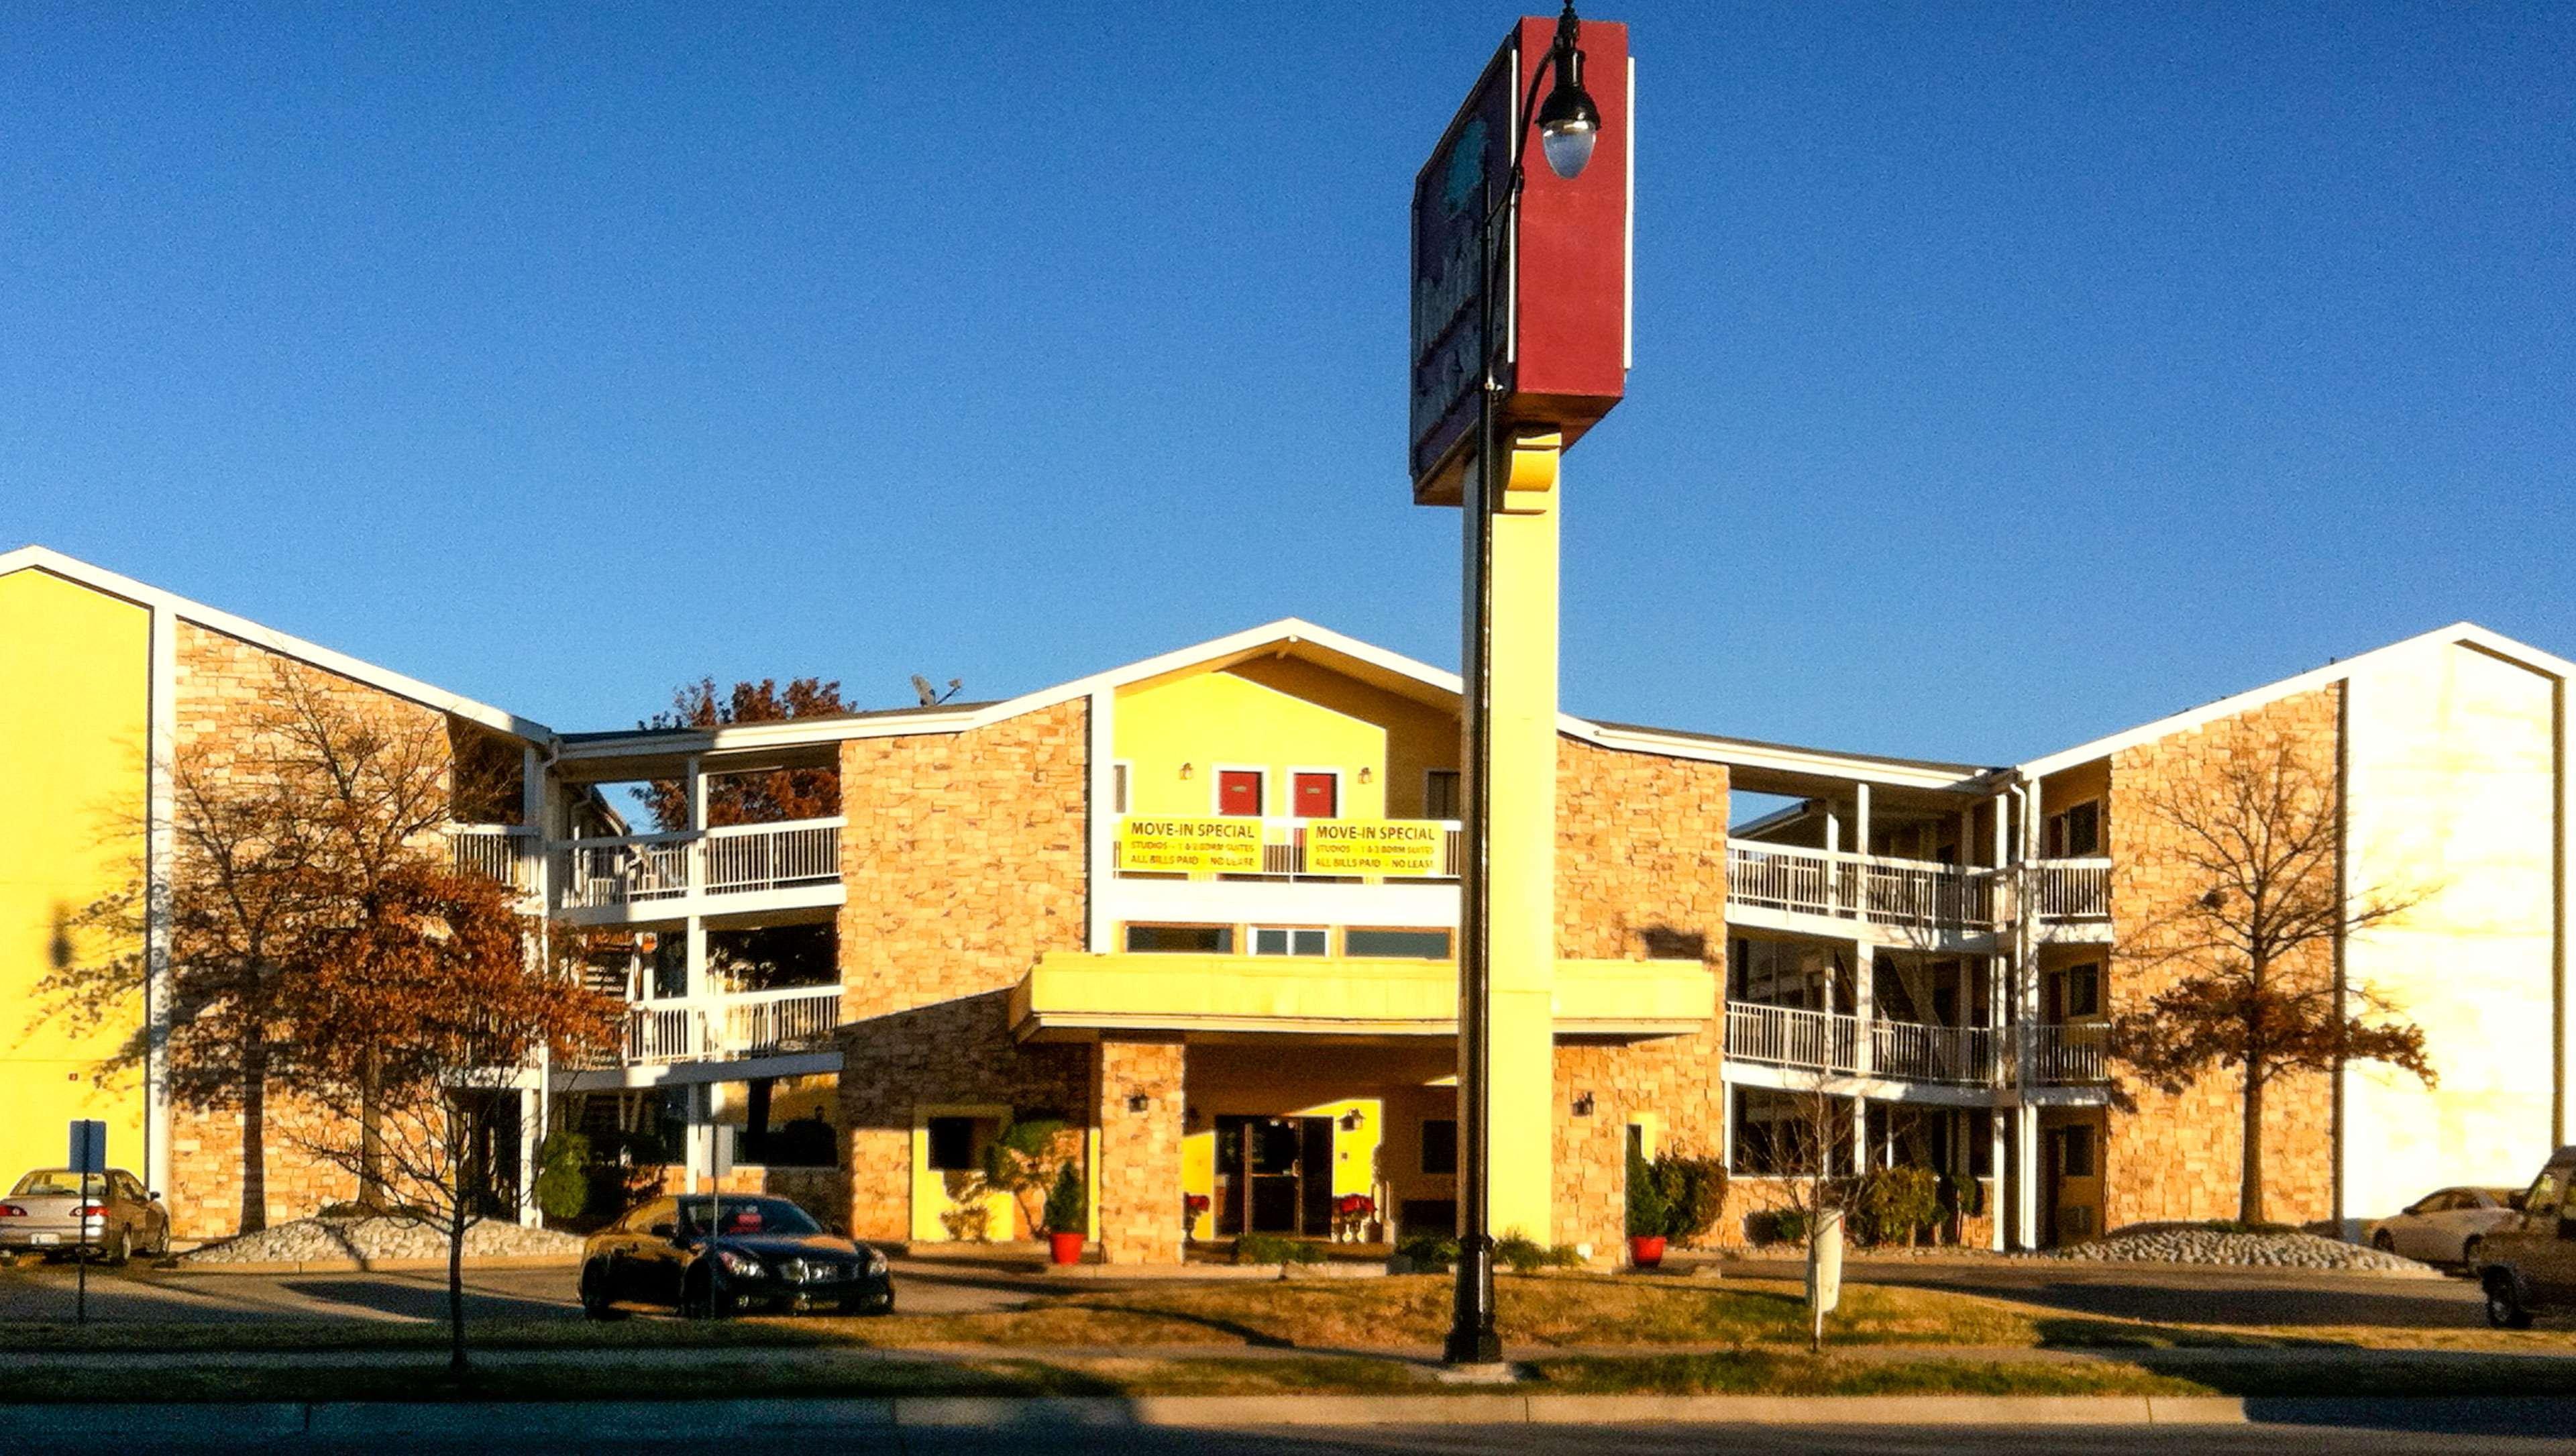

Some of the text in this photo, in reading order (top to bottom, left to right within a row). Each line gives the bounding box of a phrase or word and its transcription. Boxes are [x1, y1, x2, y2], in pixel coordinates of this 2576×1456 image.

[1131, 822, 1254, 838] MOVE-IN SPECIAL
[1316, 825, 1435, 840] MOVE-IN SPECIAL
[1130, 841, 1167, 850] STUDIOS
[1226, 843, 1254, 853] SUITES
[1316, 844, 1350, 853] STUDIOS
[1407, 846, 1434, 855] SUITES
[1130, 854, 1148, 864] ALL
[1150, 855, 1174, 864] BILLS
[1177, 855, 1198, 865] PAID
[1210, 857, 1224, 866] NO
[1316, 857, 1332, 867] ALL
[1333, 858, 1357, 868] BILLS
[1359, 858, 1381, 868] PAID
[1391, 859, 1405, 868] NO
